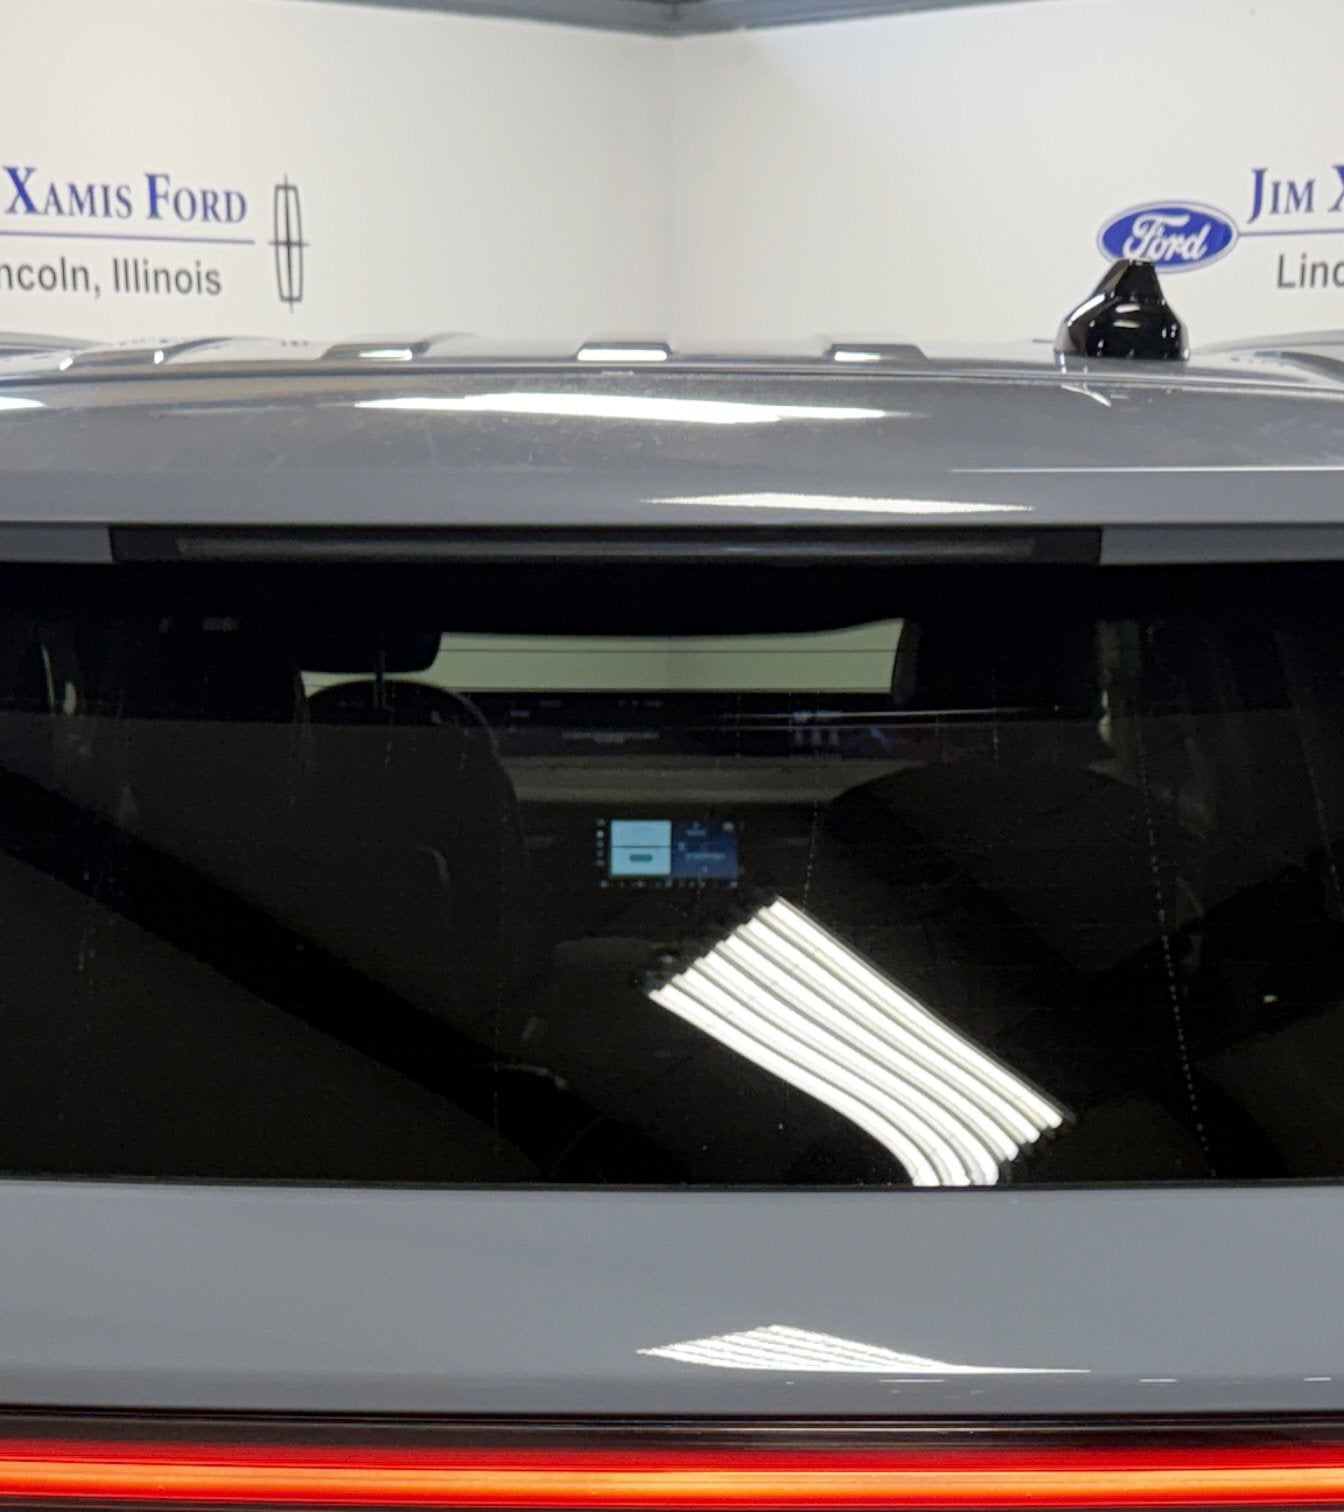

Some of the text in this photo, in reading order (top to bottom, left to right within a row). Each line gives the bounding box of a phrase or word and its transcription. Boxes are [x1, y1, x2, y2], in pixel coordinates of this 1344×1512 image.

[2, 166, 134, 219] XAMIS
[144, 172, 248, 224] FORD
[1247, 167, 1316, 224] JIM
[1121, 213, 1210, 262] Ford
[113, 257, 223, 296] Illinois
